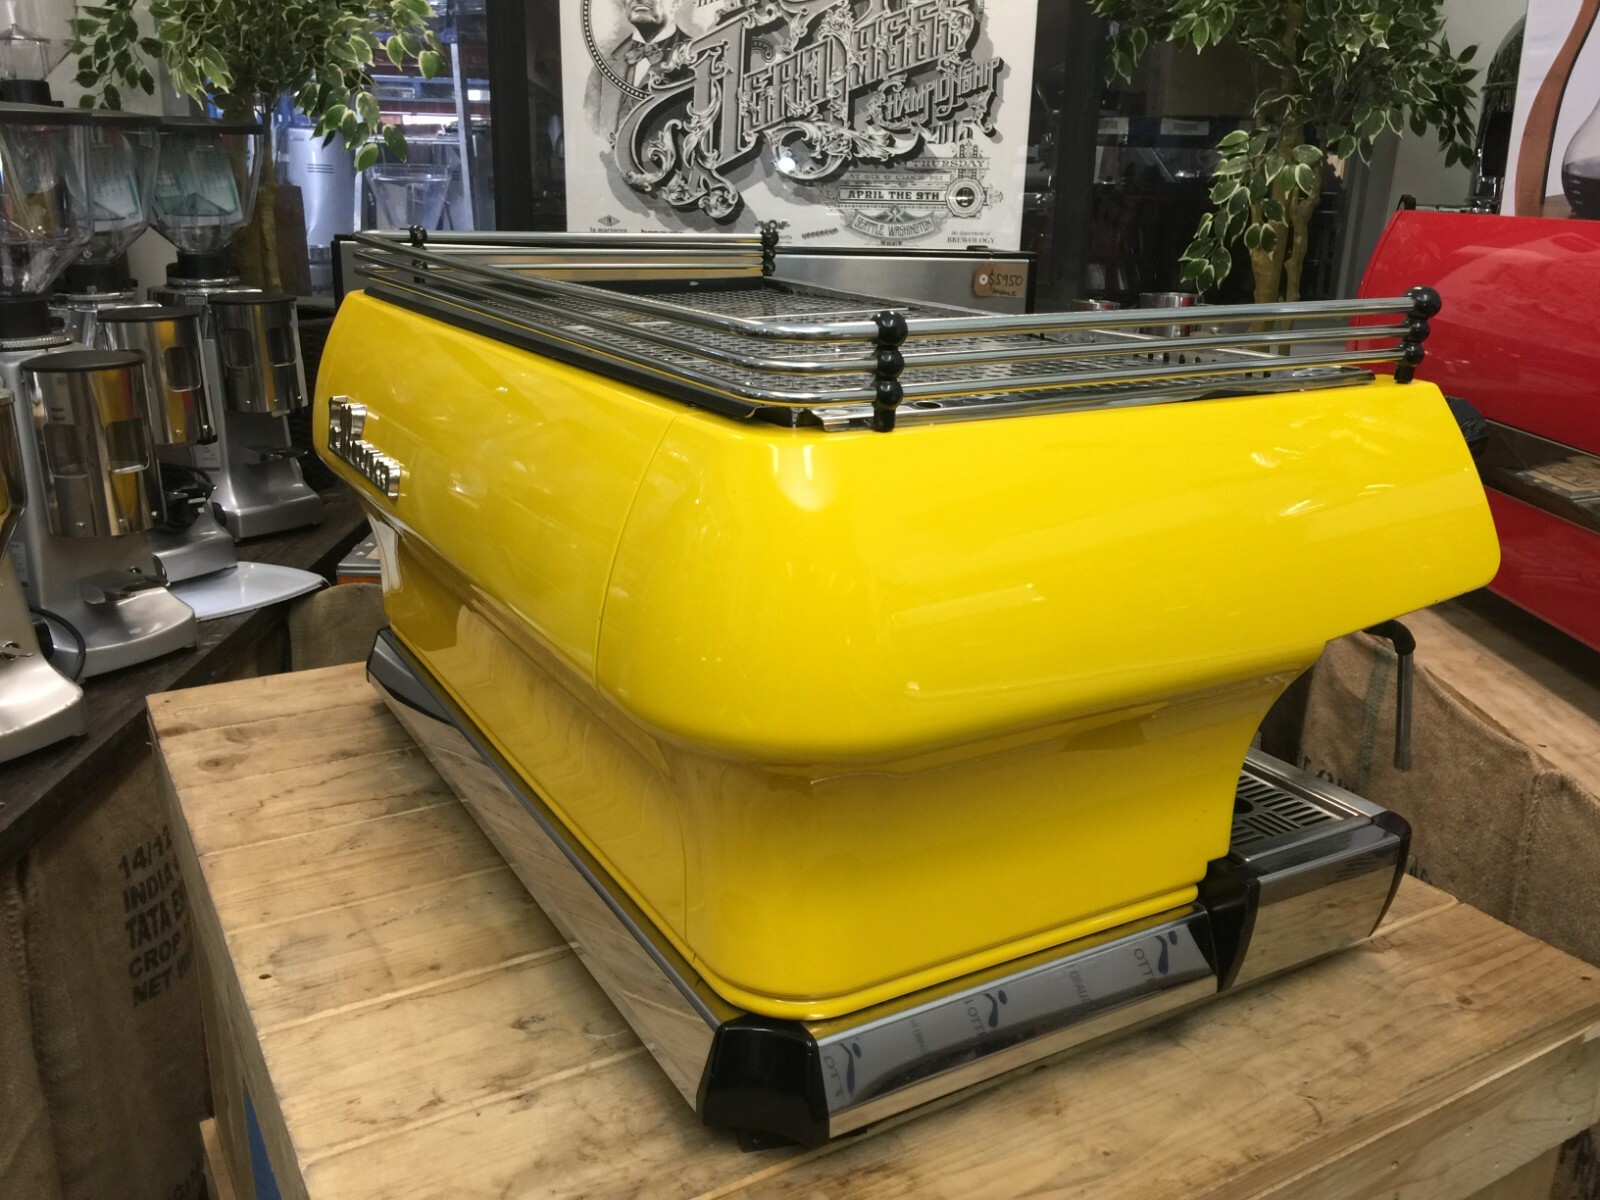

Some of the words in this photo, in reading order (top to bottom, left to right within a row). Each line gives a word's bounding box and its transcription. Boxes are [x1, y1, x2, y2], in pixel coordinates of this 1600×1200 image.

[913, 159, 985, 168] THURSDAY
[847, 190, 884, 199] APRIL
[888, 191, 912, 199] THE
[916, 191, 940, 200] 9TH
[854, 216, 885, 236] SEATTLE
[888, 216, 934, 237] WASHINGTON
[122, 861, 174, 914] INDIA
[124, 900, 172, 950] TATA
[128, 929, 181, 980] CROP
[132, 964, 173, 1009] NET
